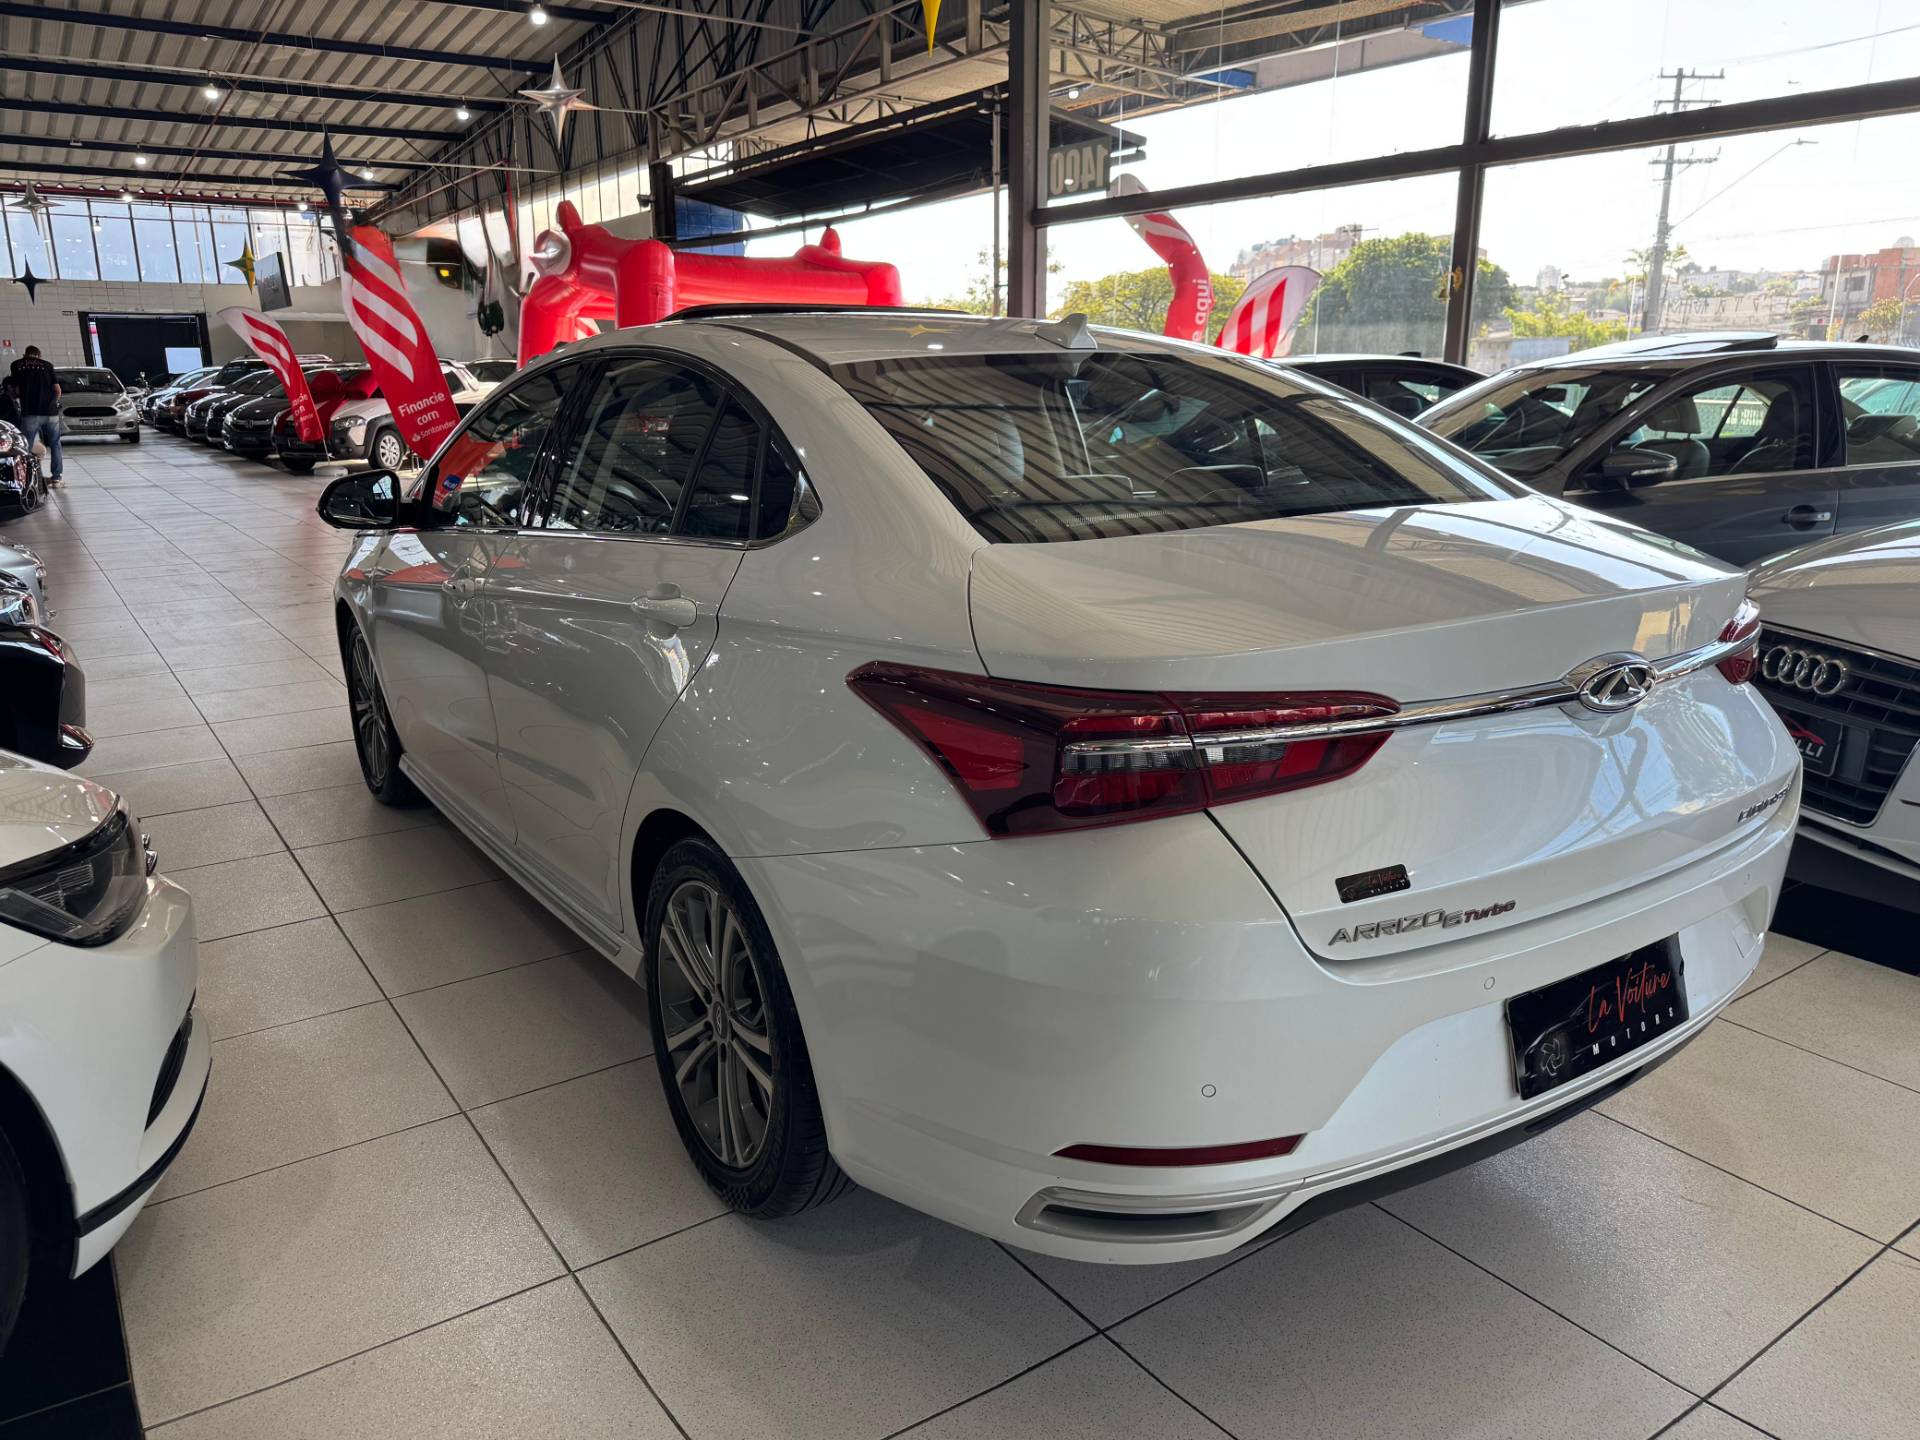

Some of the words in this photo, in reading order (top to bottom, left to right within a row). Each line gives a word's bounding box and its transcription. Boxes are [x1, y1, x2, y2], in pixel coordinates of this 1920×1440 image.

[1192, 279, 1212, 325] aqui
[397, 391, 446, 417] Financie
[416, 410, 440, 426] com
[420, 420, 456, 439] Santander
[1587, 985, 1613, 1033] La
[1615, 961, 1671, 1024] Voiture
[1592, 1007, 1674, 1056] MOTORS
